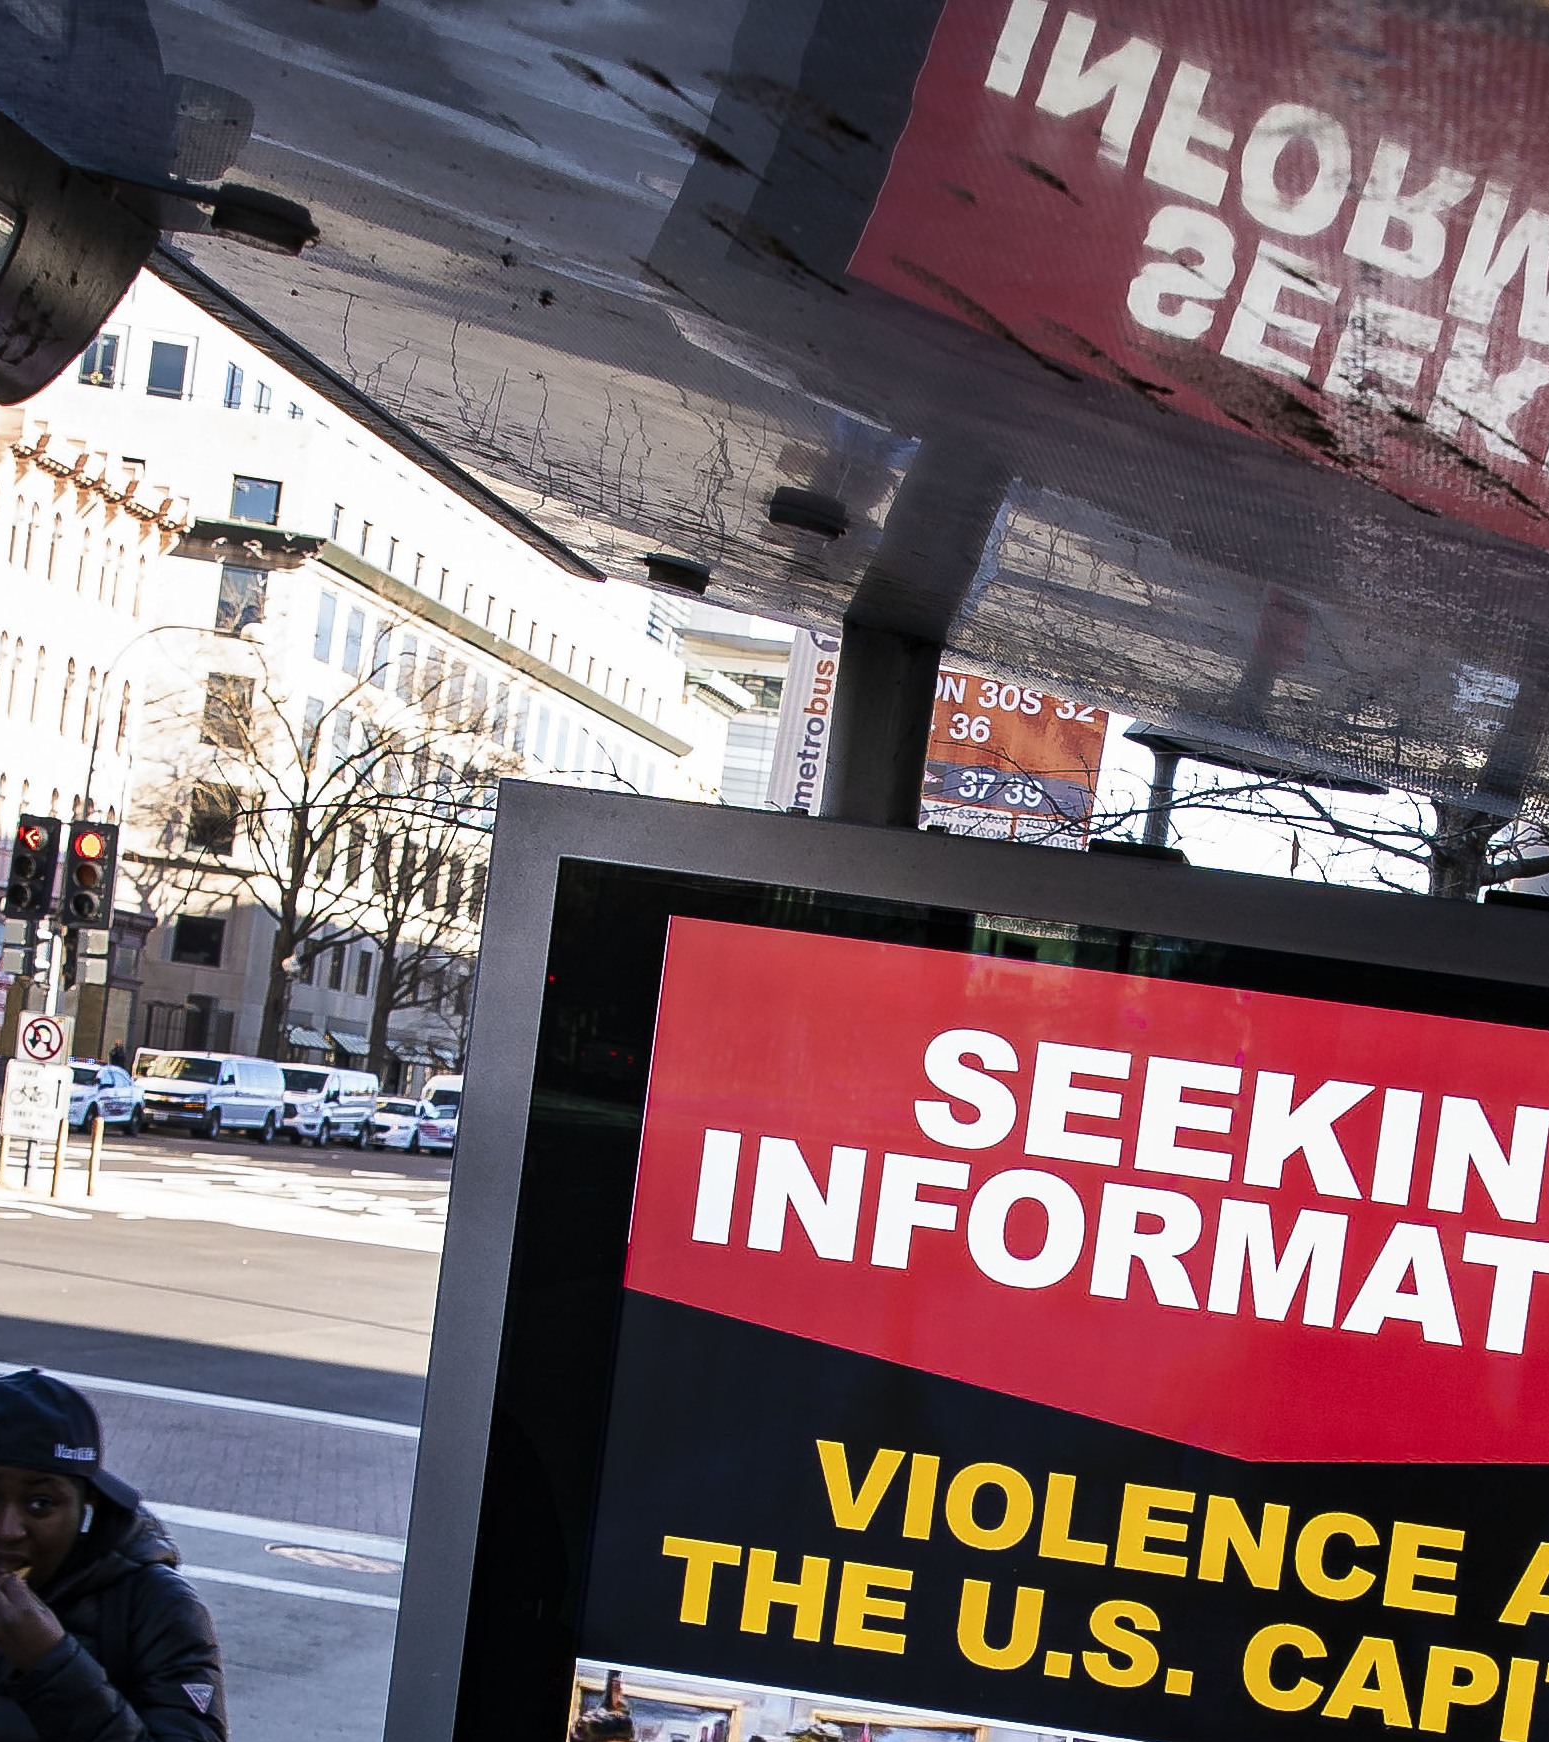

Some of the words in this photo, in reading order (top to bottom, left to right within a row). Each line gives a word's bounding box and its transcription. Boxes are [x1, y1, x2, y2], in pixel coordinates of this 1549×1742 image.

[793, 658, 838, 811] metrobus
[948, 712, 992, 744] 36
[978, 680, 1044, 715] 30S
[958, 770, 998, 800] 37
[1003, 776, 1045, 808] 39
[814, 1440, 1466, 1618] VIOLENCE
[661, 1535, 915, 1655] THE
[956, 1577, 1195, 1697] U.S.
